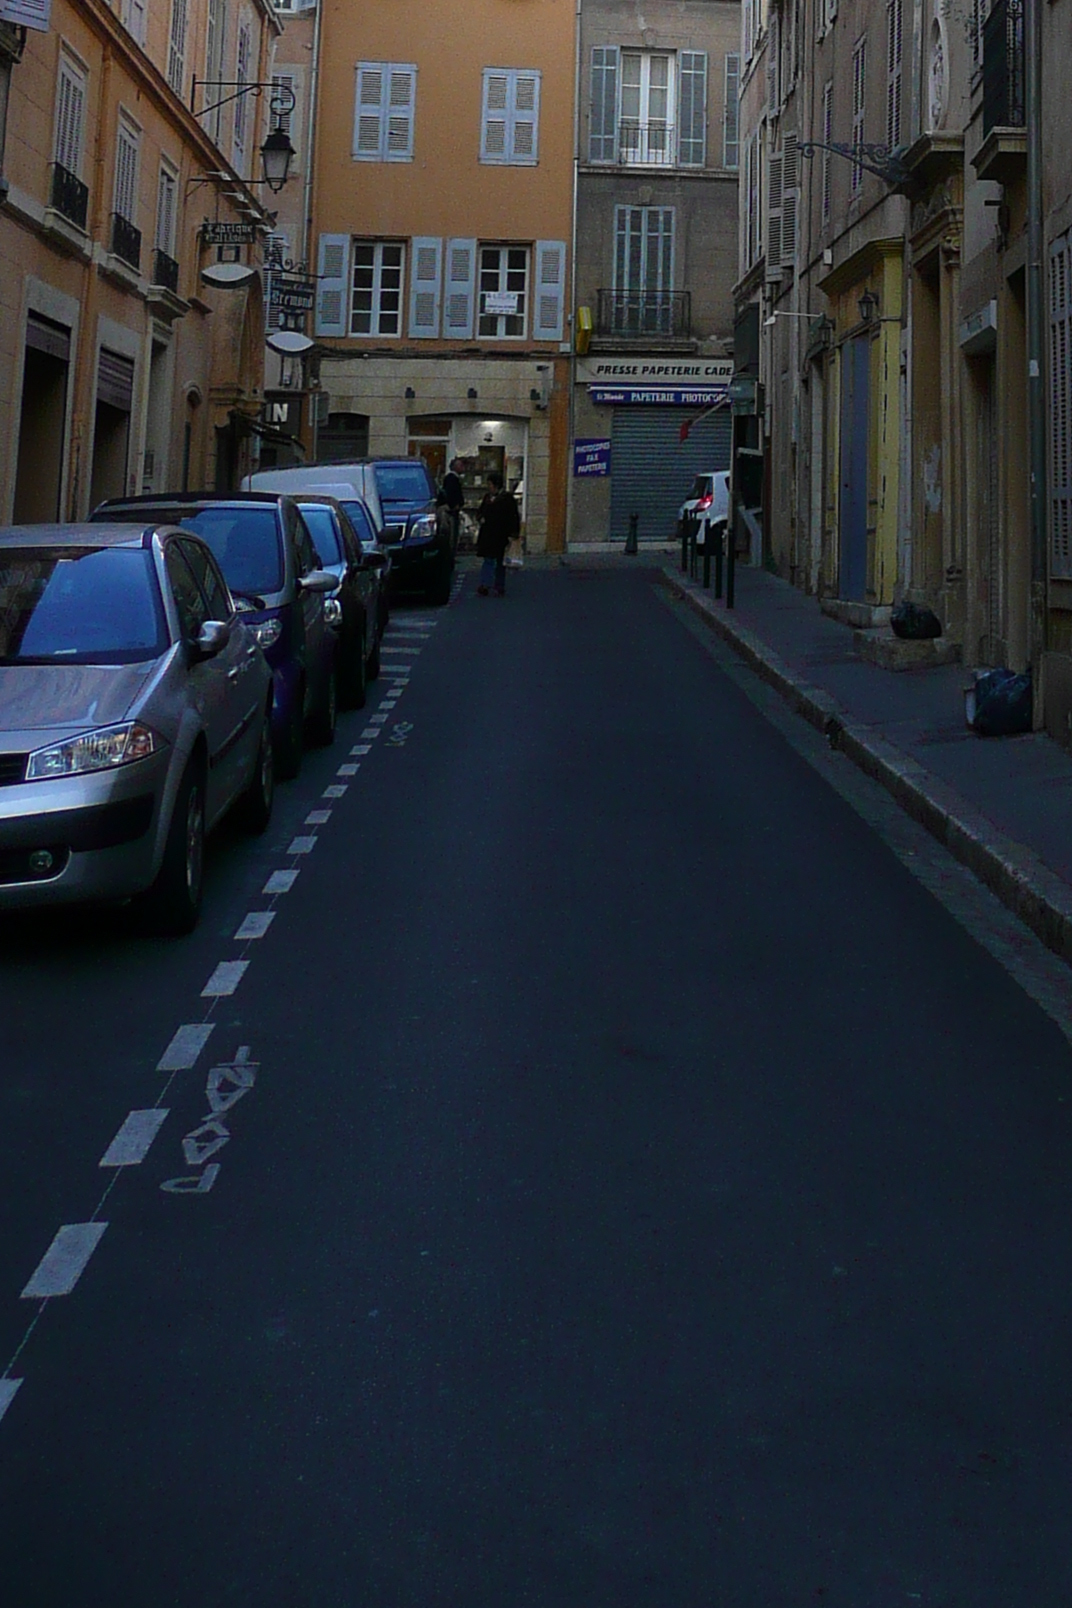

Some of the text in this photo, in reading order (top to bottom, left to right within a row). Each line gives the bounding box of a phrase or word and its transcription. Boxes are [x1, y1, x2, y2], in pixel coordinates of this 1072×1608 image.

[597, 365, 638, 375] PRESSE
[642, 366, 701, 376] PAPETERIE
[631, 392, 675, 402] PAPETERIE
[586, 453, 599, 462] FAX
